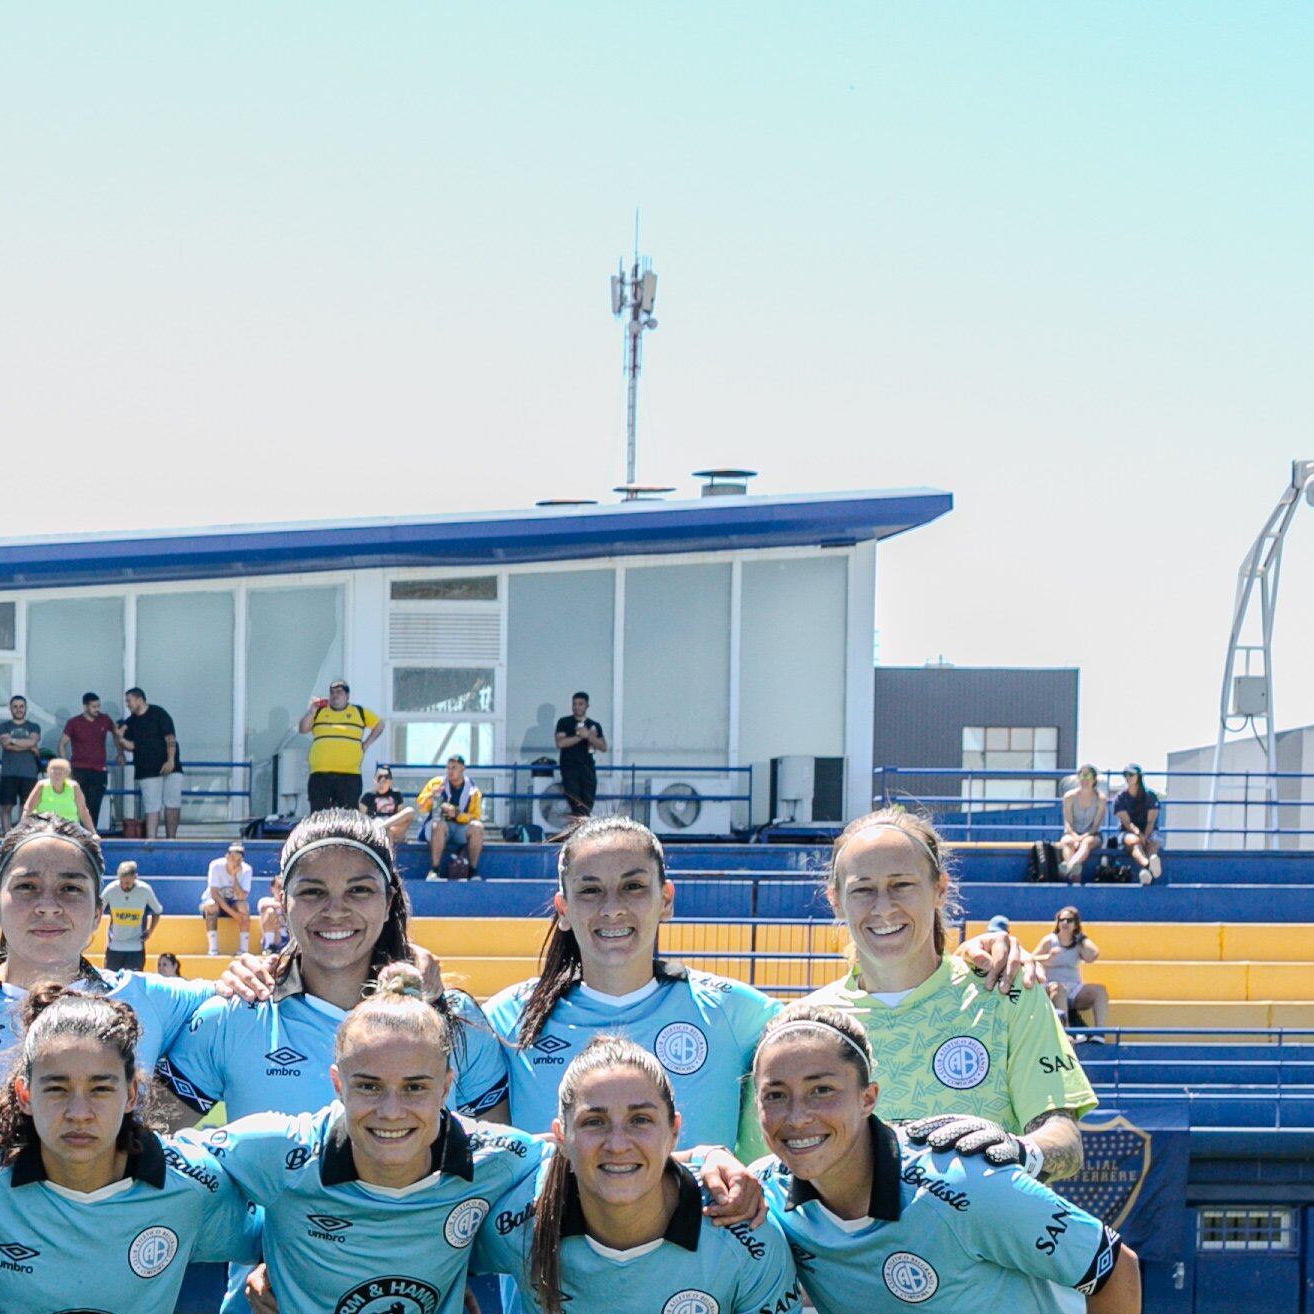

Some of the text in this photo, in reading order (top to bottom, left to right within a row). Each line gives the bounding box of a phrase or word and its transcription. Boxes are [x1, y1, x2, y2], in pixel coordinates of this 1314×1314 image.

[533, 1055, 565, 1065] umbro
[266, 1068, 301, 1077] umbro
[903, 1165, 971, 1212] Batiste
[307, 1229, 345, 1244] umbro
[368, 1283, 383, 1296] &
